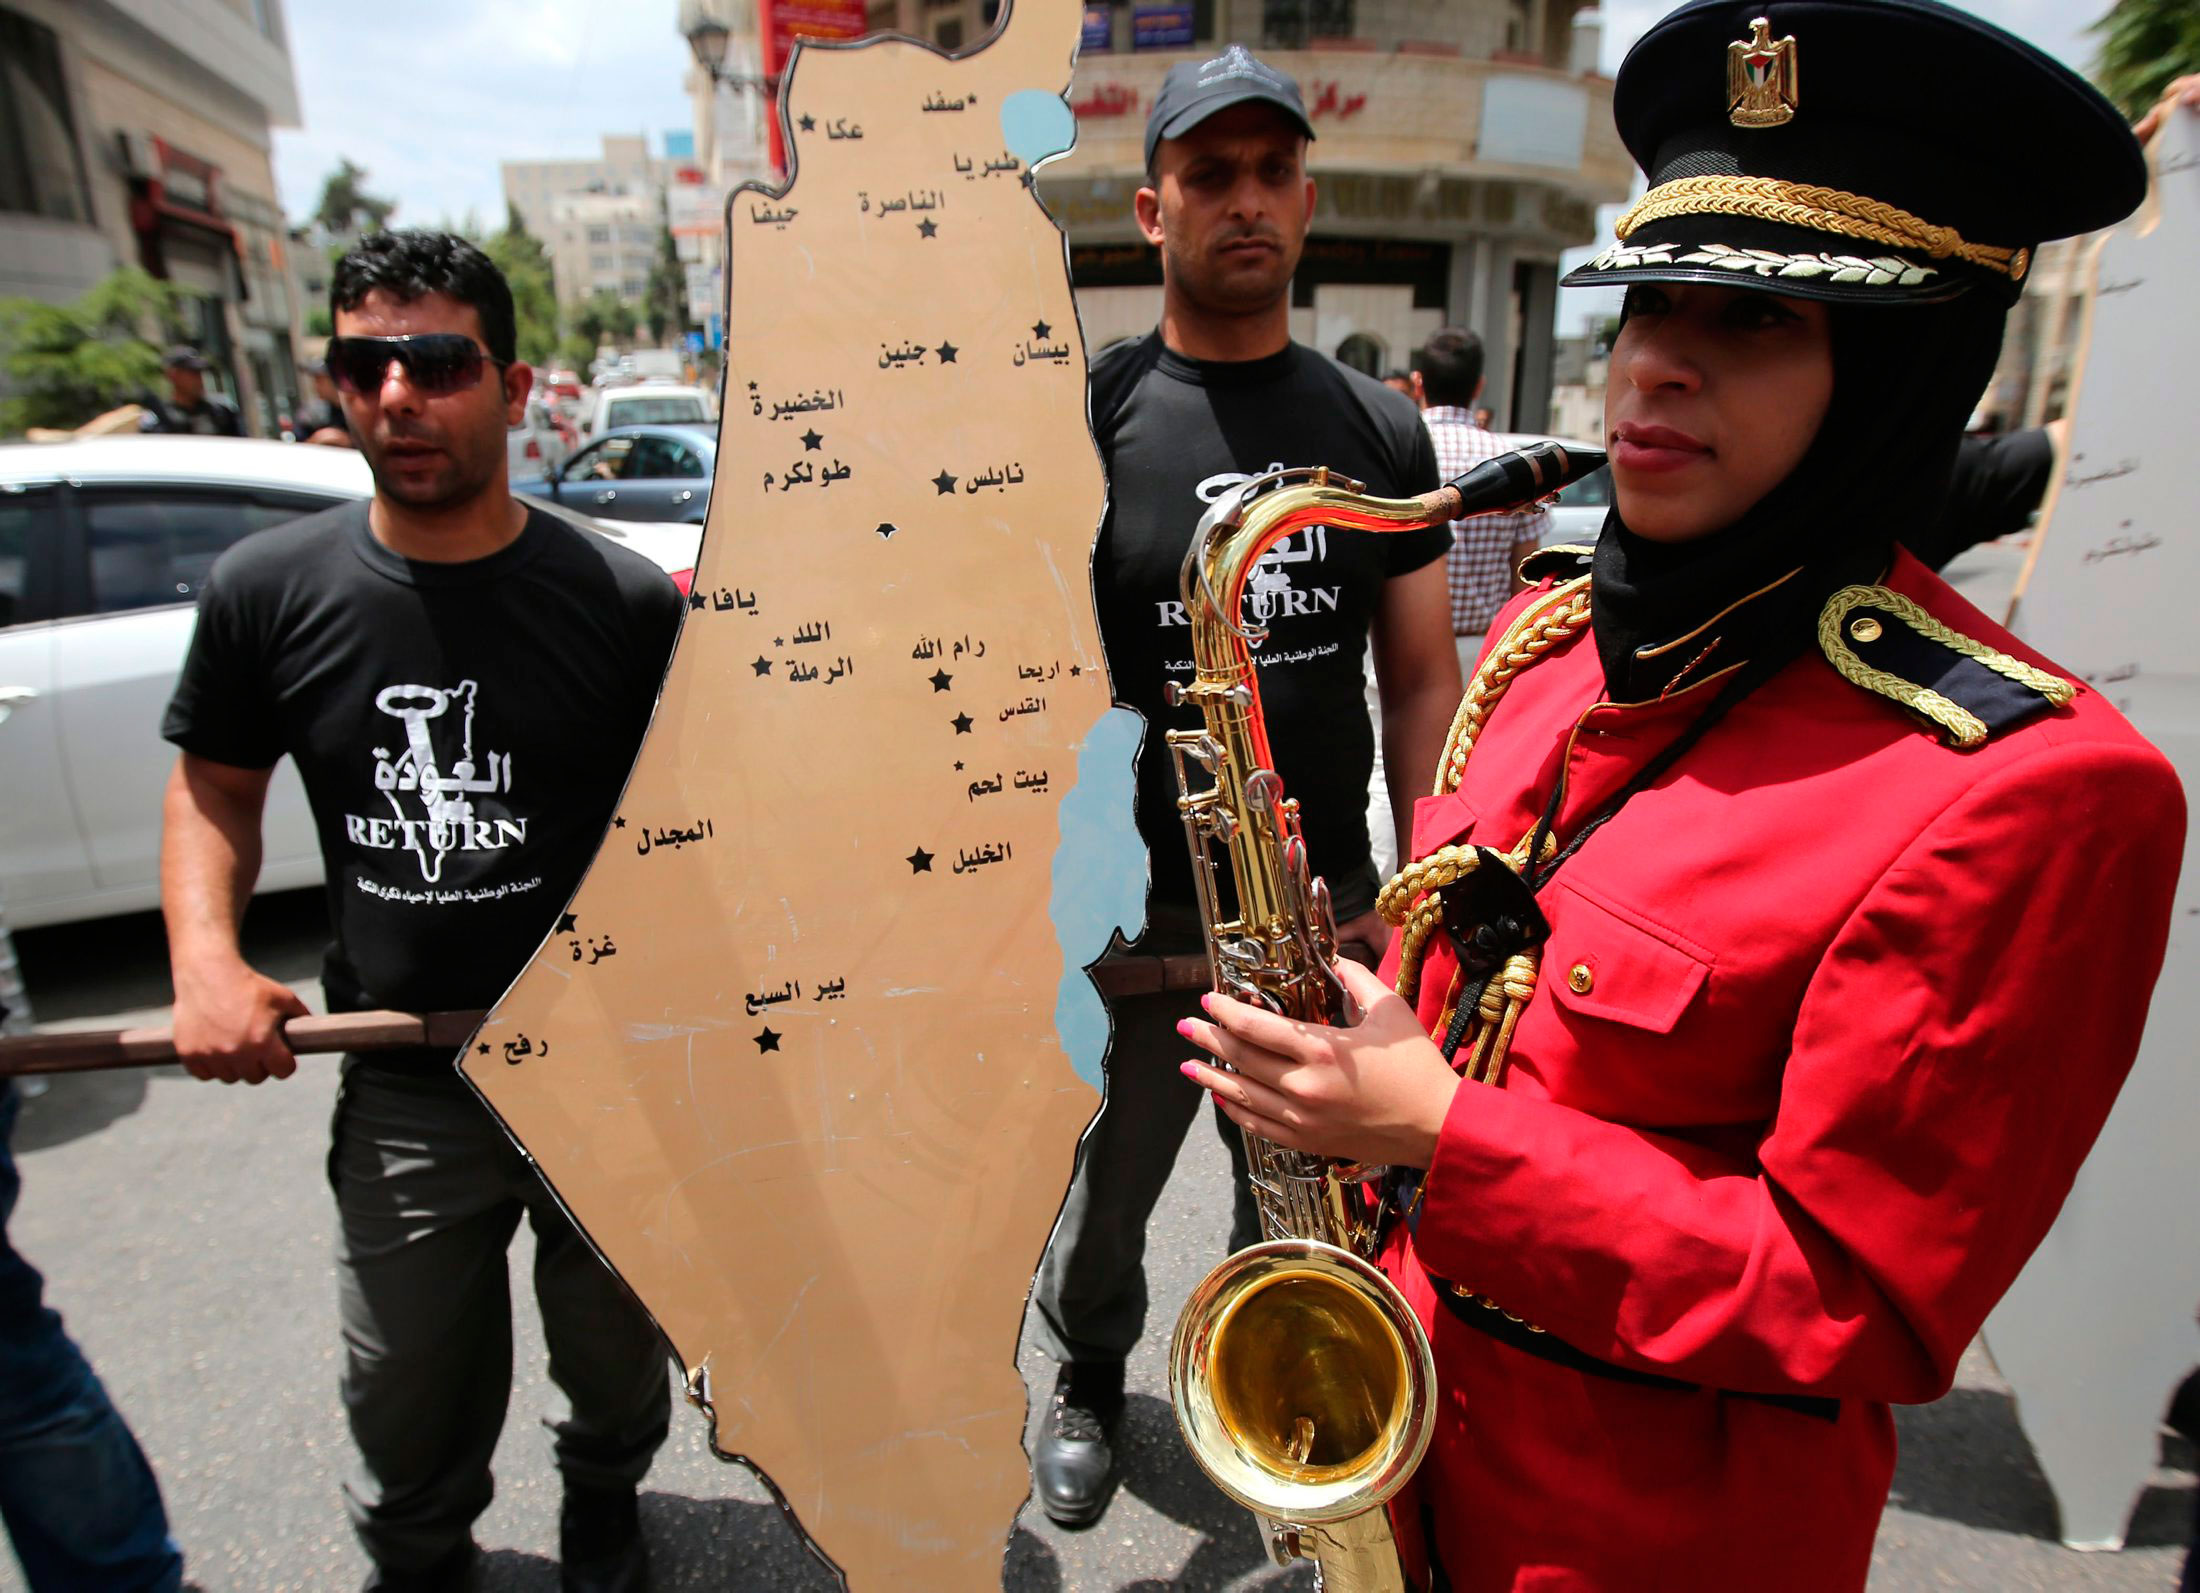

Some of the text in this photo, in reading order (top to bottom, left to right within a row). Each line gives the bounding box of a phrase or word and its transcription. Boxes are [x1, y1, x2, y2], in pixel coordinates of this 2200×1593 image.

[922, 91, 965, 113] صفد
[826, 119, 864, 141] عكا
[953, 151, 1019, 179] طبريا
[751, 203, 798, 231] حيفا
[858, 190, 945, 218] الناصرة
[878, 340, 927, 369] جنين
[1013, 341, 1070, 367] بيسان
[751, 389, 844, 420] الخضيرة
[763, 458, 852, 493] طولكرم
[965, 462, 1024, 495] نابلس
[712, 587, 759, 616] يافا
[1155, 586, 1341, 627] RURN
[792, 620, 831, 645] اللد
[911, 634, 986, 662] رام الله
[1259, 653, 1282, 667] العليا
[1284, 648, 1316, 664] الوطنية
[1317, 643, 1339, 657] اللجنة
[785, 656, 853, 685] الرملة
[1018, 660, 1060, 683] اريحا
[1164, 659, 1195, 673] النكبة
[999, 697, 1047, 722] القدس
[371, 746, 512, 807] العودة
[967, 770, 1049, 803] بيت لحم
[345, 814, 528, 851] RETURN
[637, 818, 713, 856] المجدل
[952, 841, 1012, 875] الخليل
[435, 890, 463, 905] العليا
[464, 884, 509, 903] الوطنية
[510, 876, 542, 893] اللجنة
[569, 936, 617, 963] غزة
[745, 976, 846, 1014] بير السبع
[503, 1032, 549, 1066] رفح
